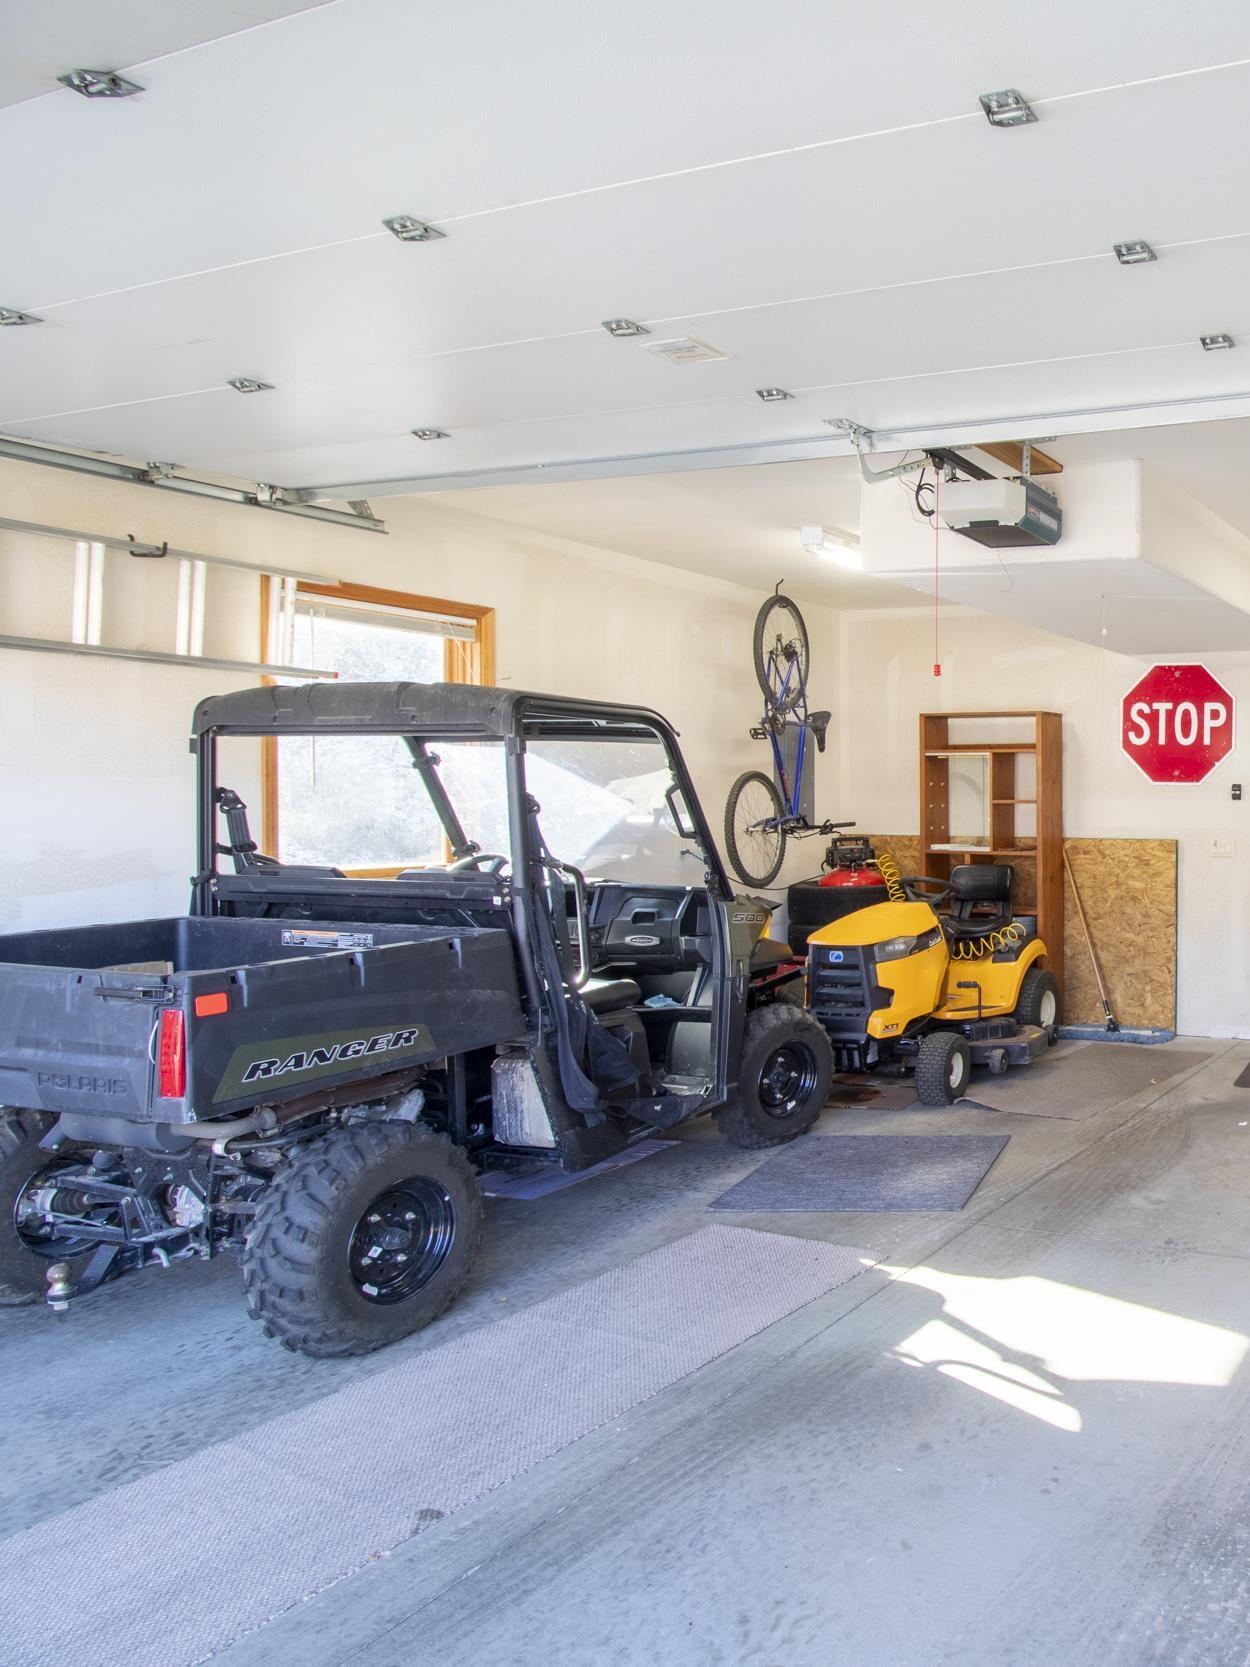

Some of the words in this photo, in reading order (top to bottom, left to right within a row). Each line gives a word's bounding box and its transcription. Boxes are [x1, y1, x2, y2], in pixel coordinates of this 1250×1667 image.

[1128, 701, 1227, 746] STOP
[732, 912, 765, 924] 500
[242, 1029, 418, 1082] RANGER
[37, 1071, 128, 1096] POLARIS
